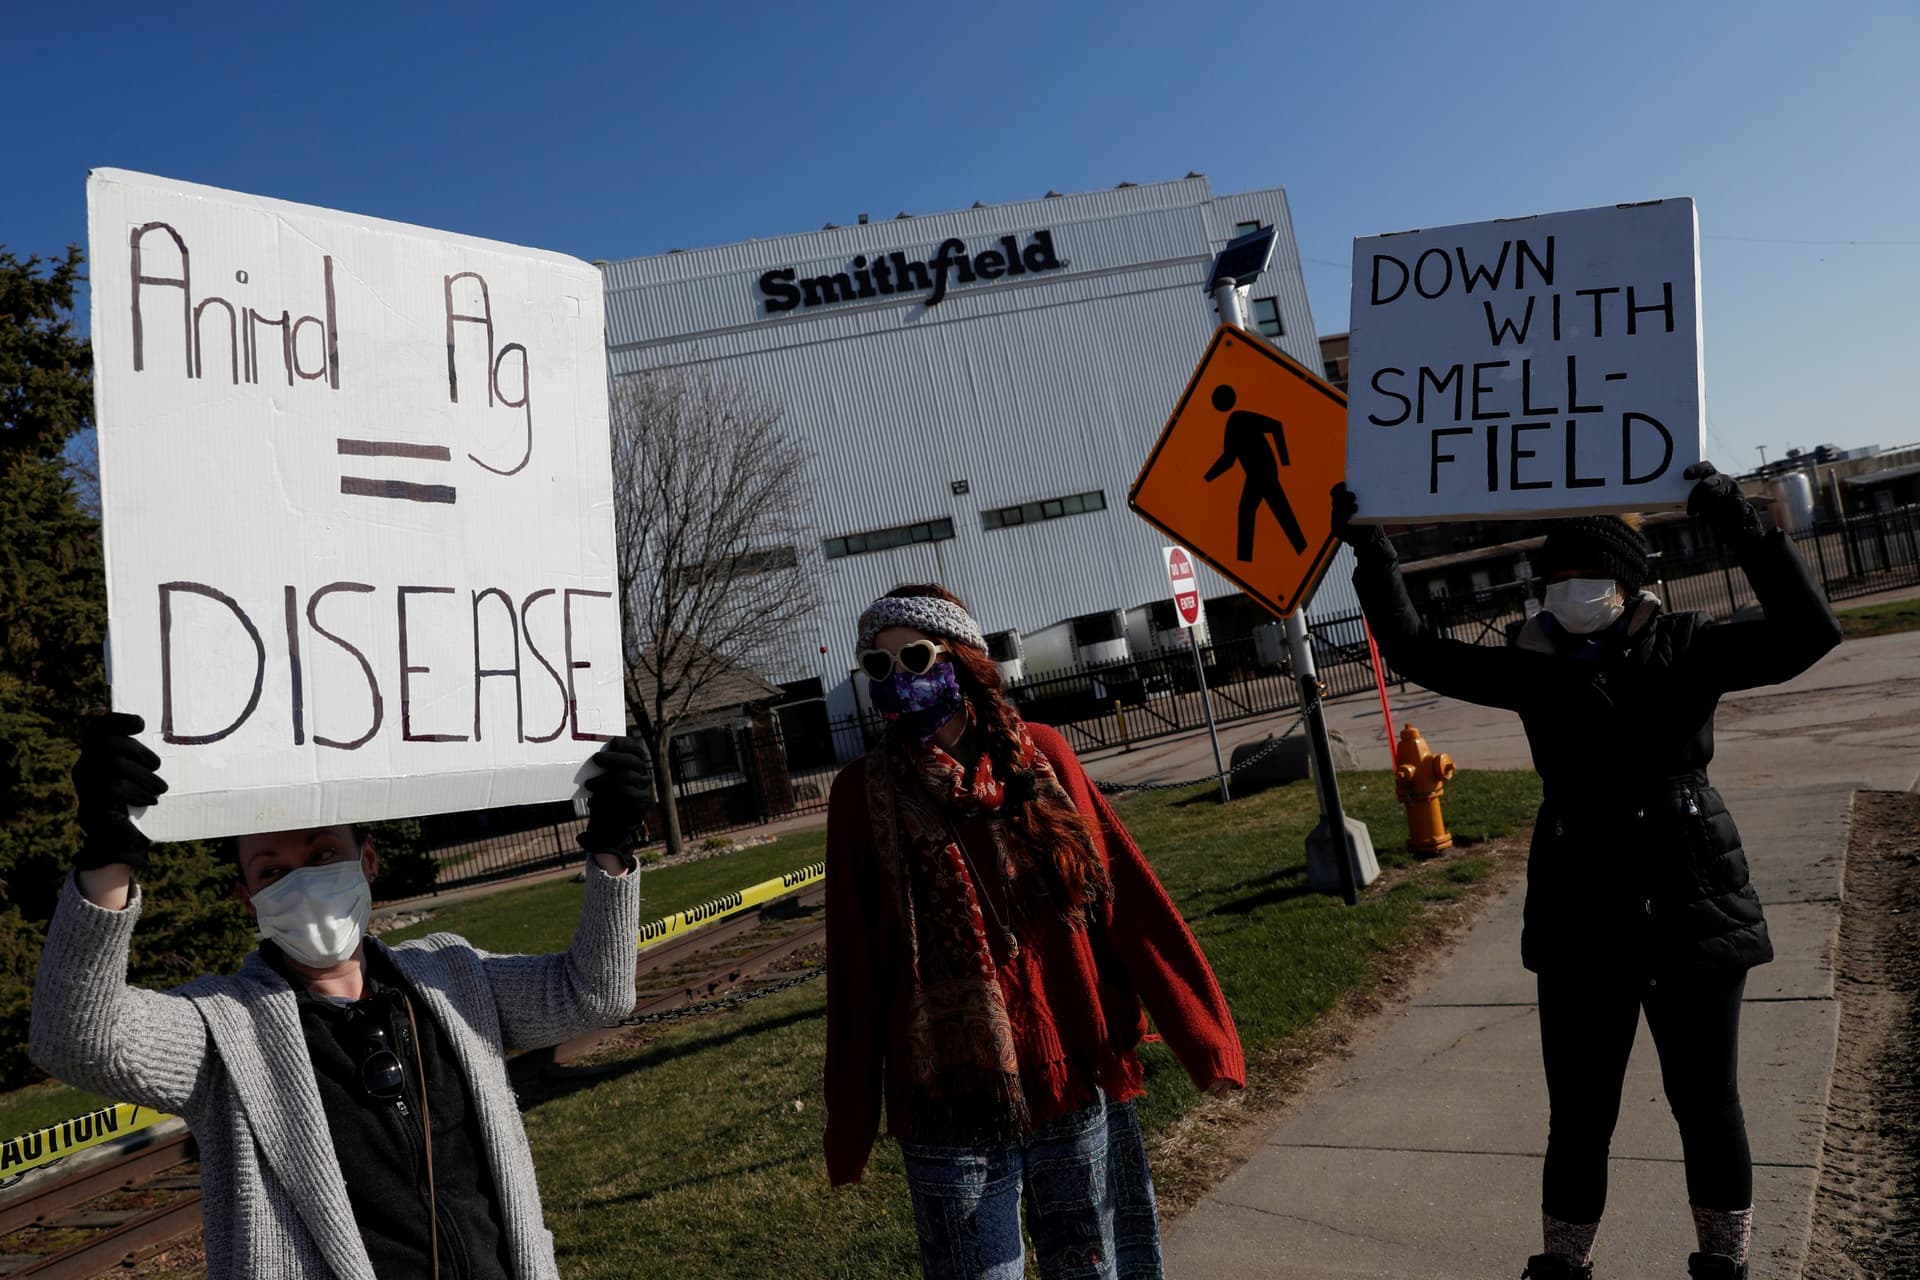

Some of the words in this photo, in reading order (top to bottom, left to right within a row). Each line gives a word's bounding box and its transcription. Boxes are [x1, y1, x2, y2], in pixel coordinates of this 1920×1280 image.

[759, 229, 1061, 313] Smithfield
[1371, 235, 1555, 306] DOWN
[1483, 282, 1674, 346] WITH
[444, 271, 533, 476] Ag
[1368, 355, 1628, 427] SMELL-
[1430, 412, 1674, 494] FIELD
[158, 580, 613, 750] DISEASE
[682, 891, 742, 925] CUIDADO
